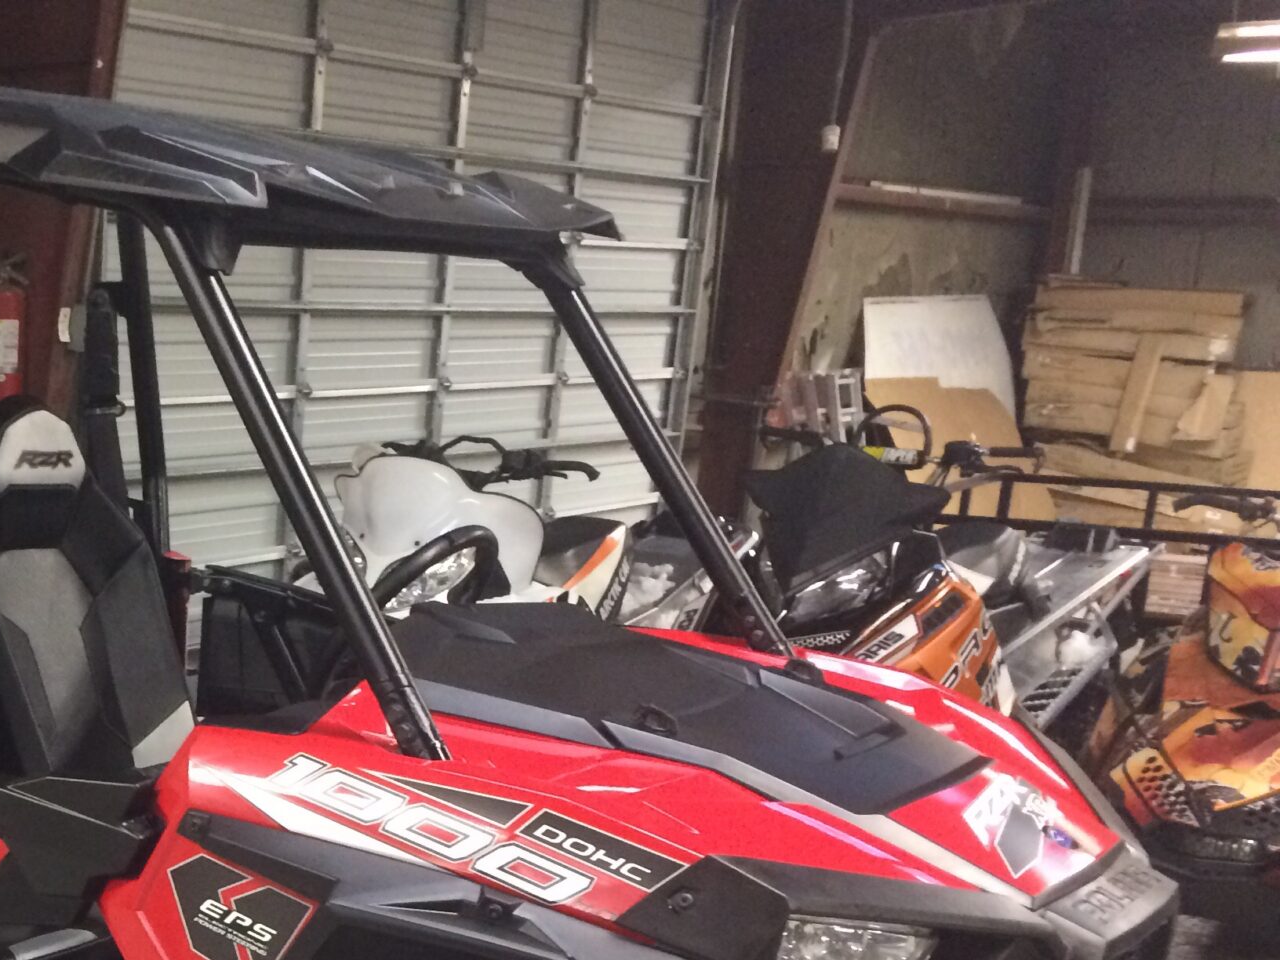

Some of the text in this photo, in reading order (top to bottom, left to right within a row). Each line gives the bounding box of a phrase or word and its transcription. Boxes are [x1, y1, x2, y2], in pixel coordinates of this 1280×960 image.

[14, 449, 73, 469] RZR
[270, 753, 598, 904] 1000
[532, 823, 652, 881] DOHC
[199, 899, 278, 942] EPS
